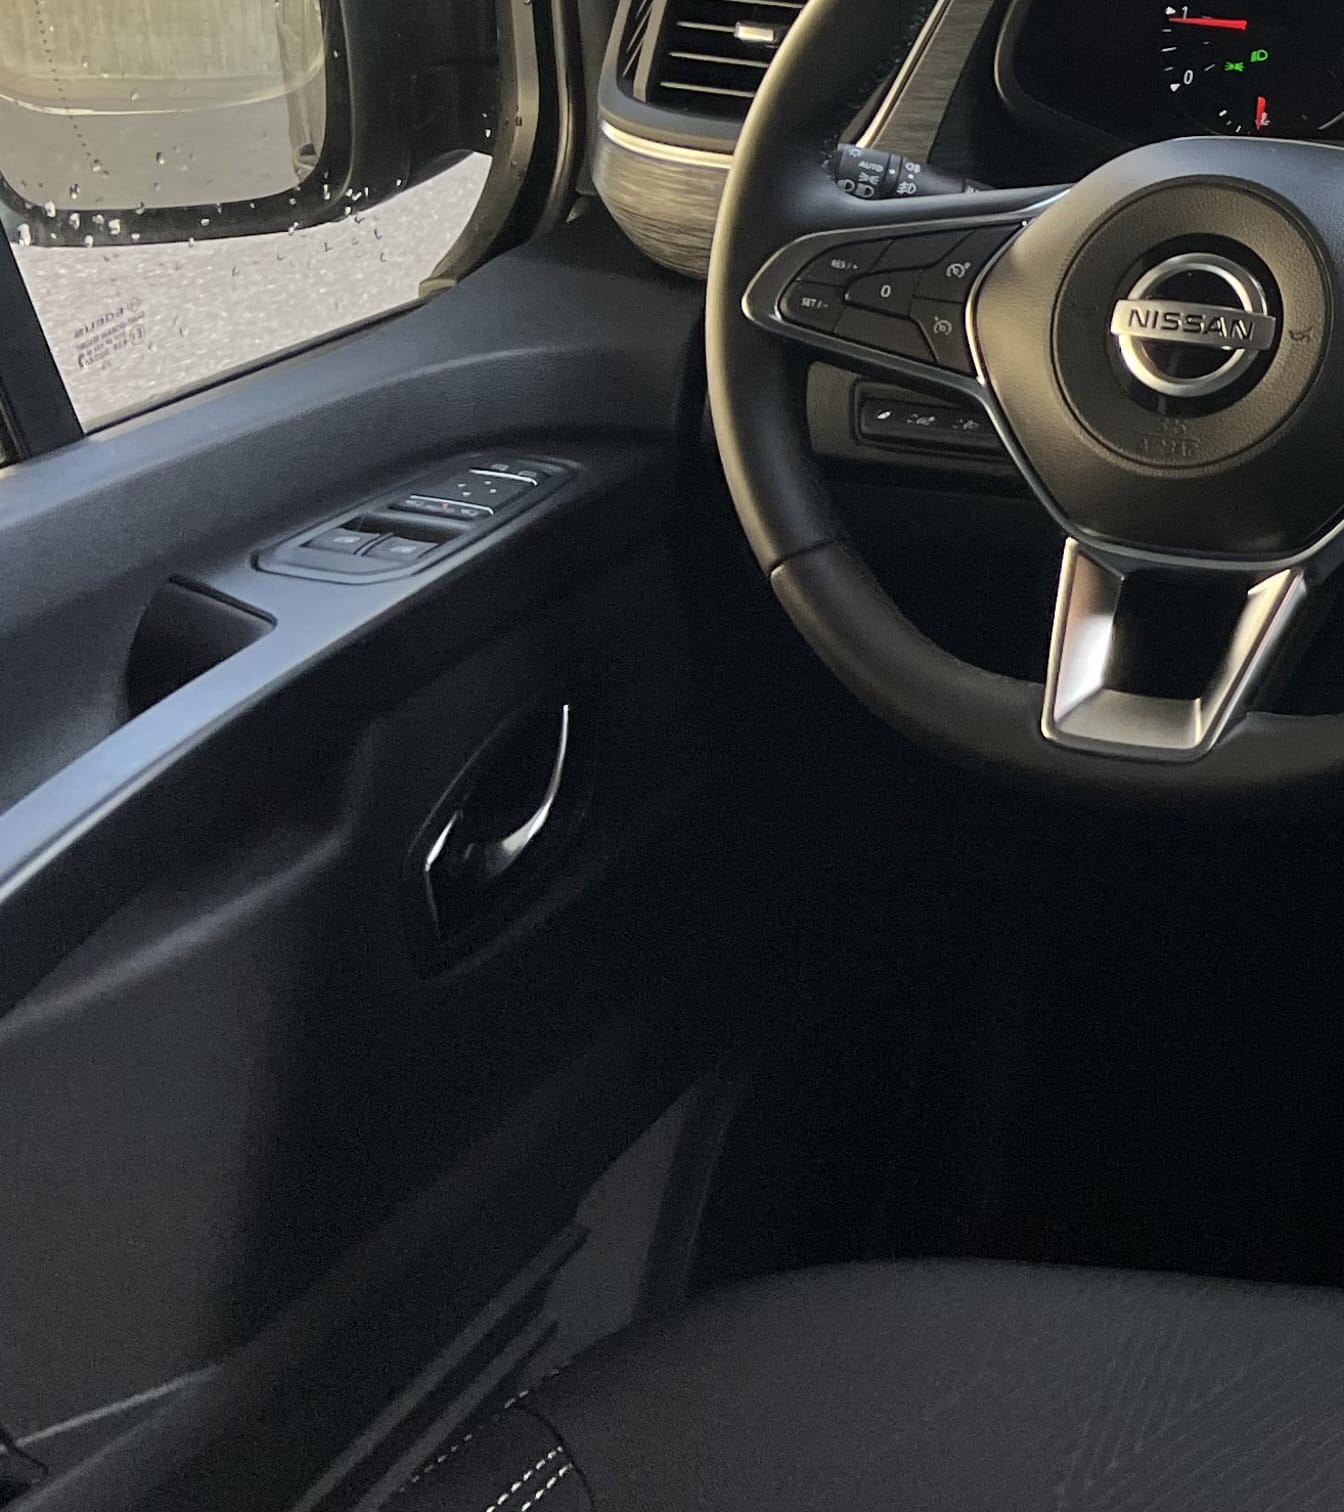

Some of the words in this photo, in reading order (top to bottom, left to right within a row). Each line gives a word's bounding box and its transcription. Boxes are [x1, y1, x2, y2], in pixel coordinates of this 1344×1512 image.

[1183, 69, 1194, 85] 0
[858, 160, 884, 173] AUTO
[1127, 308, 1256, 341] NISSAN
